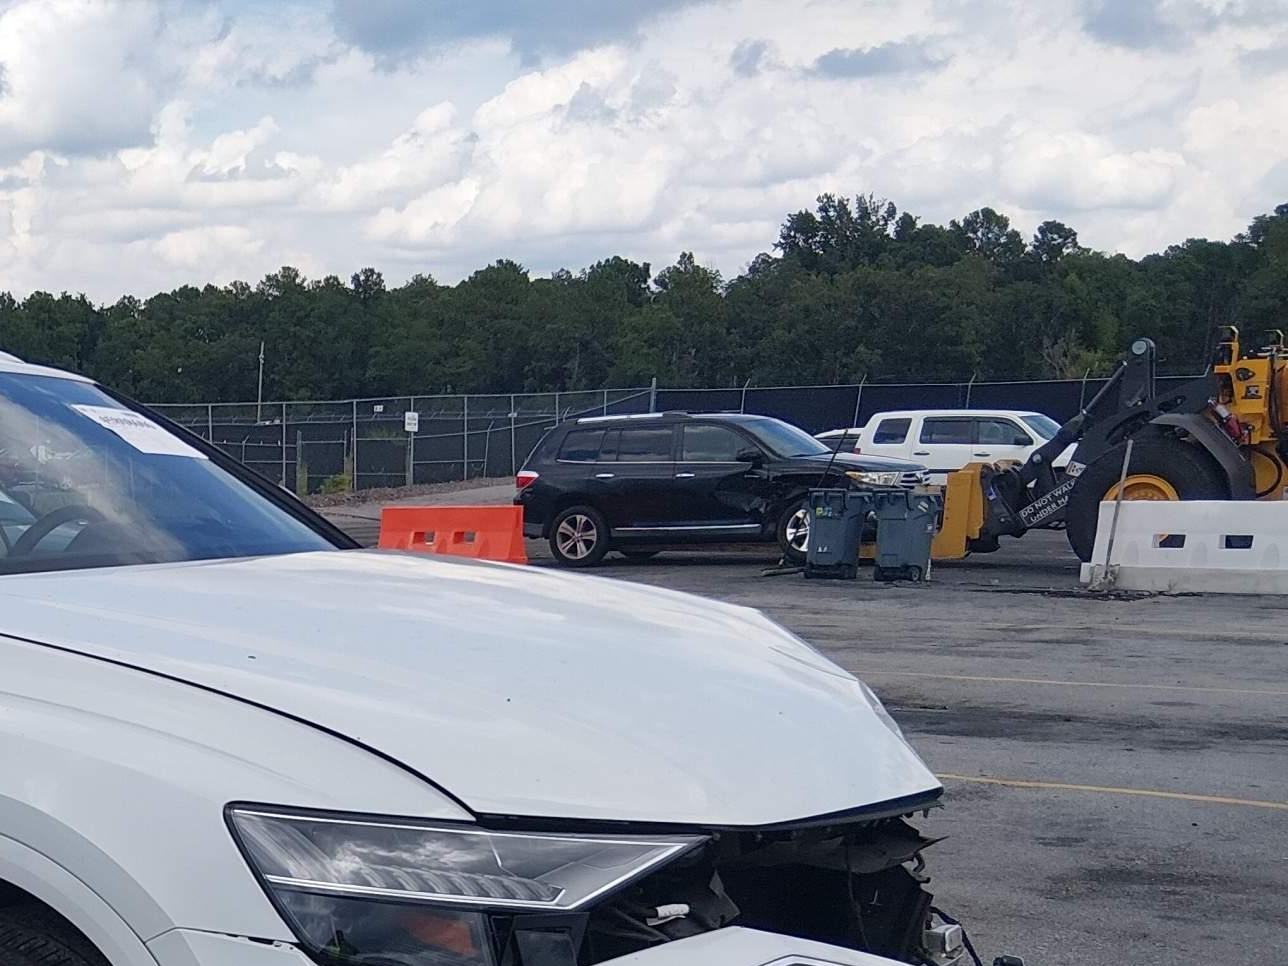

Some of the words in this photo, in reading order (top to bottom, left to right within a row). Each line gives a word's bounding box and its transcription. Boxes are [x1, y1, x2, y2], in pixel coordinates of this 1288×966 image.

[1021, 507, 1034, 518] DO
[1035, 494, 1053, 509] NOT
[1030, 504, 1057, 522] UNDER
